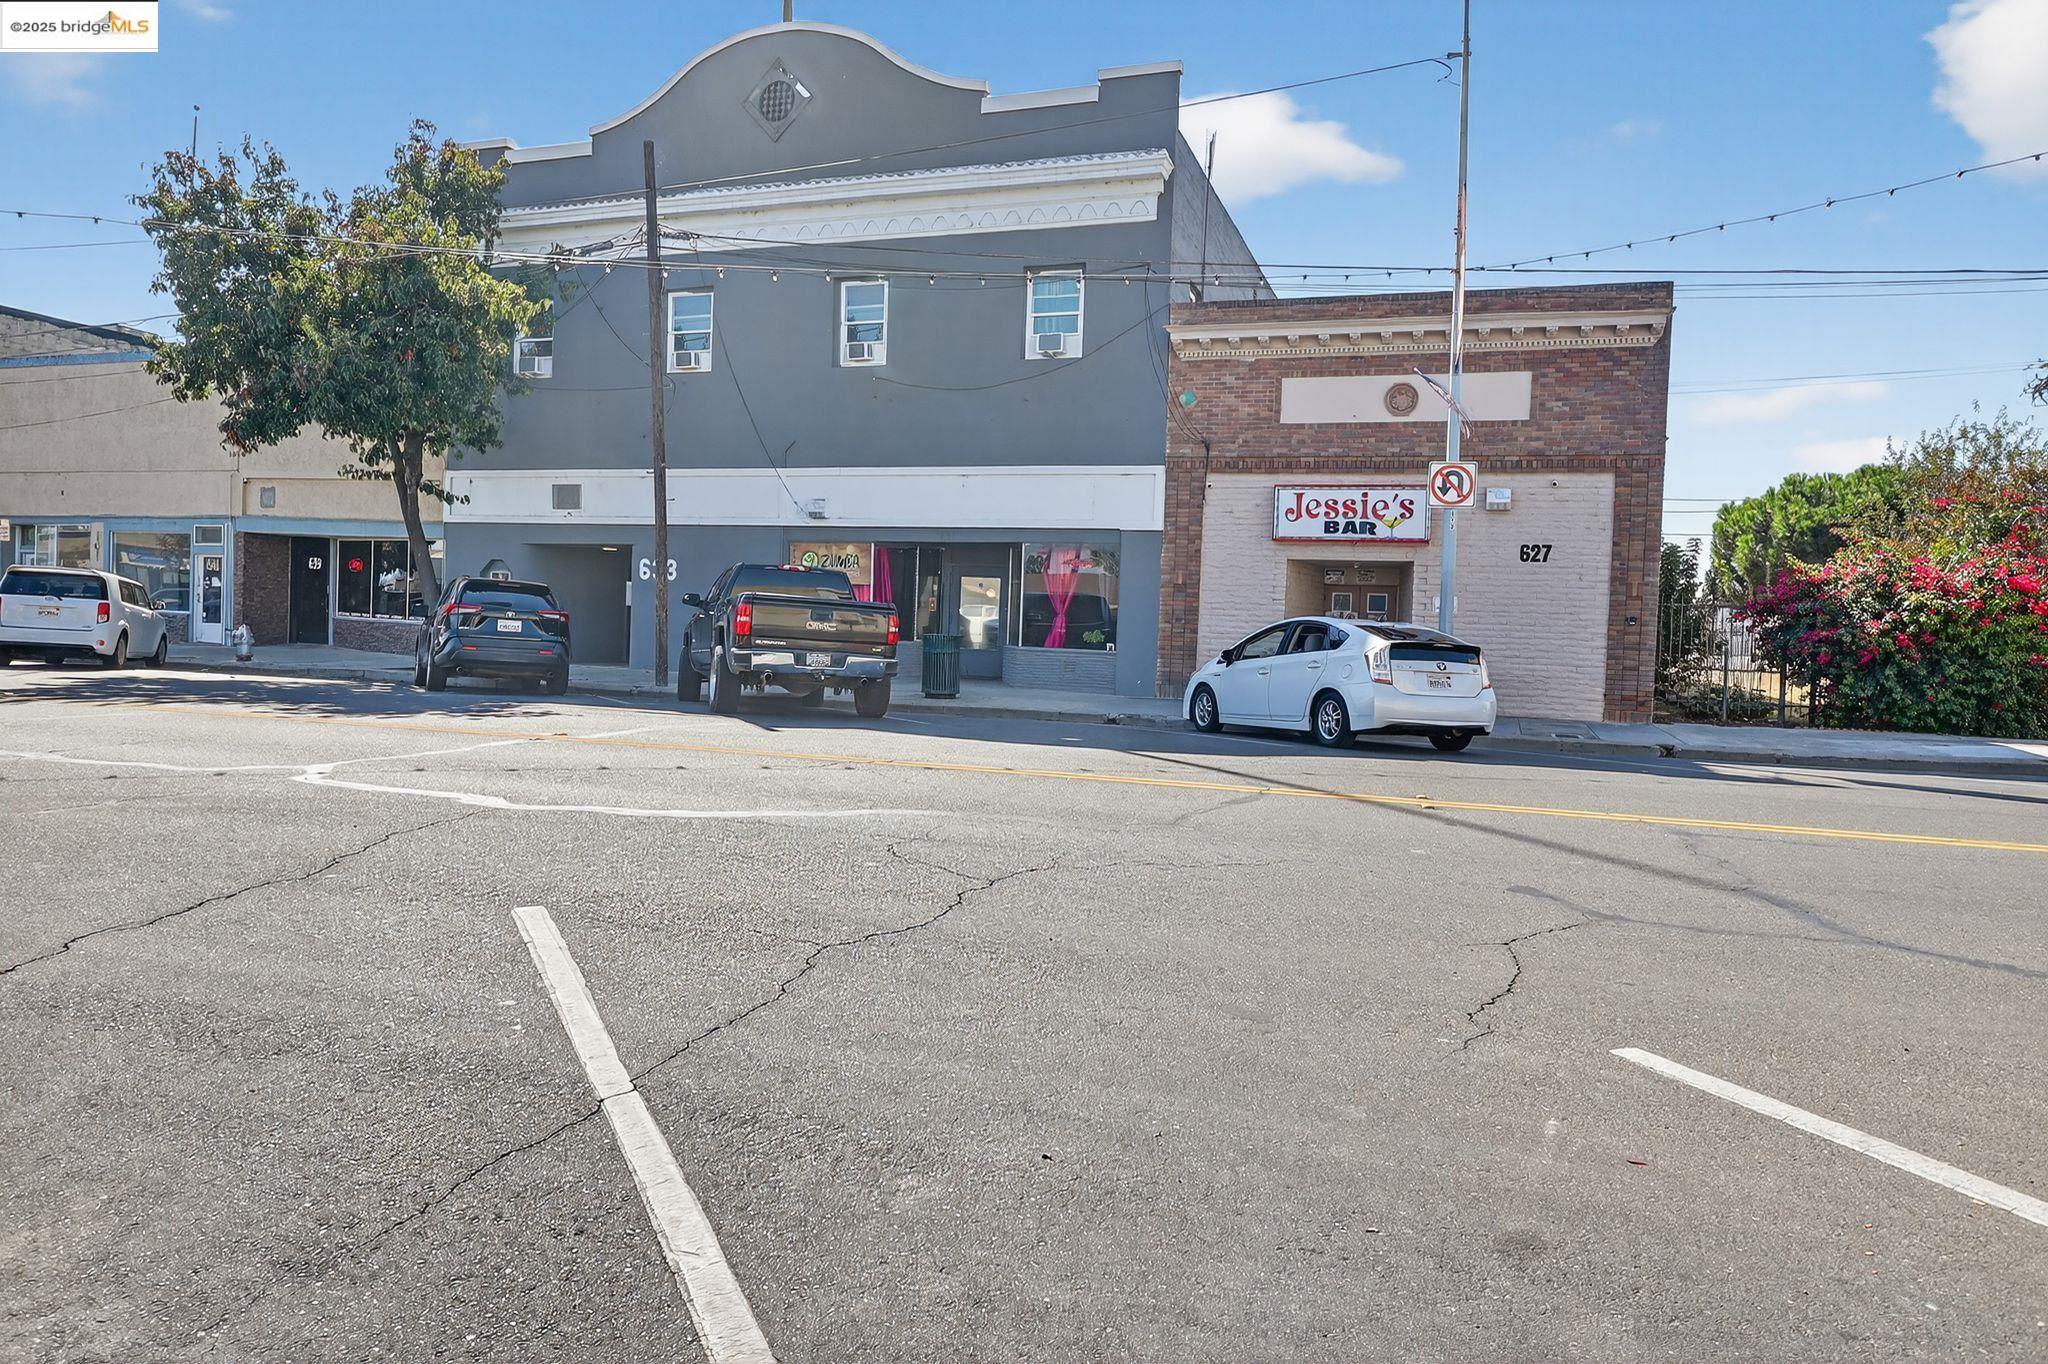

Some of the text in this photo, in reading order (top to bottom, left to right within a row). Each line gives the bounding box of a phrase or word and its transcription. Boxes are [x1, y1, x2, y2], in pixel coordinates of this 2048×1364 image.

[1284, 491, 1415, 523] Jessie's
[1323, 520, 1378, 536] BAR
[1519, 544, 1553, 563] 627
[639, 557, 678, 581] 63
